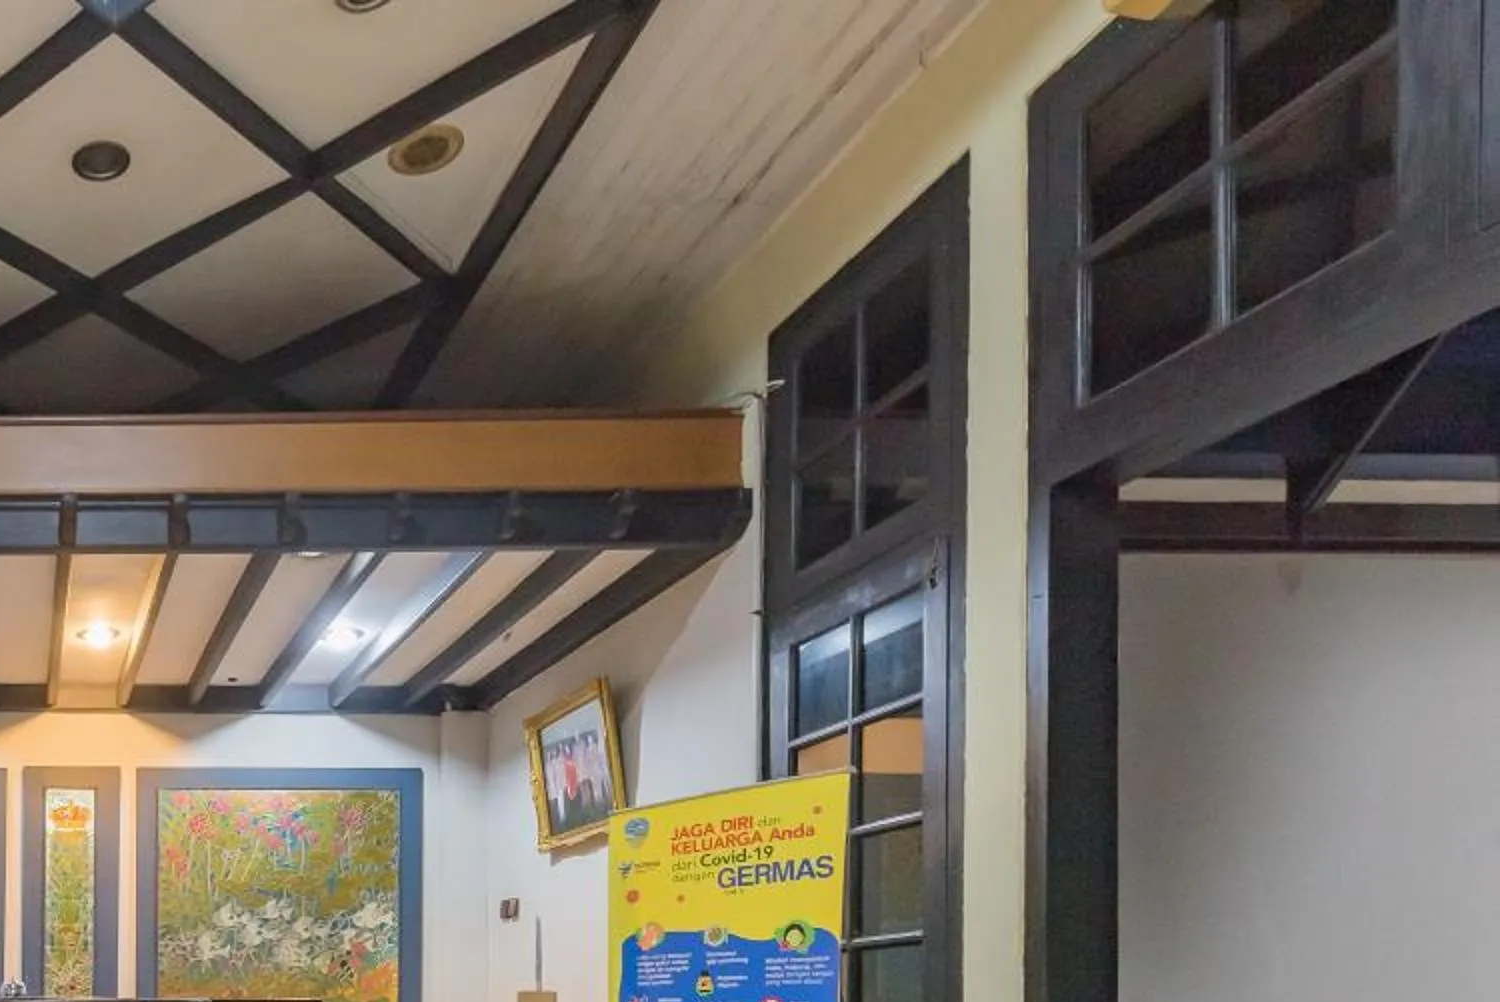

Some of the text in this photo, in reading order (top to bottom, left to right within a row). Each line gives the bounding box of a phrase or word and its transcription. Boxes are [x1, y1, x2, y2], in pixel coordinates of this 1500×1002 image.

[670, 822, 715, 841] JAGA
[720, 816, 753, 833] DIRI
[671, 824, 816, 856] KELUARGA Anda
[671, 858, 699, 873] dari
[699, 845, 774, 868] Covid-19
[717, 855, 834, 889] GERMAS
